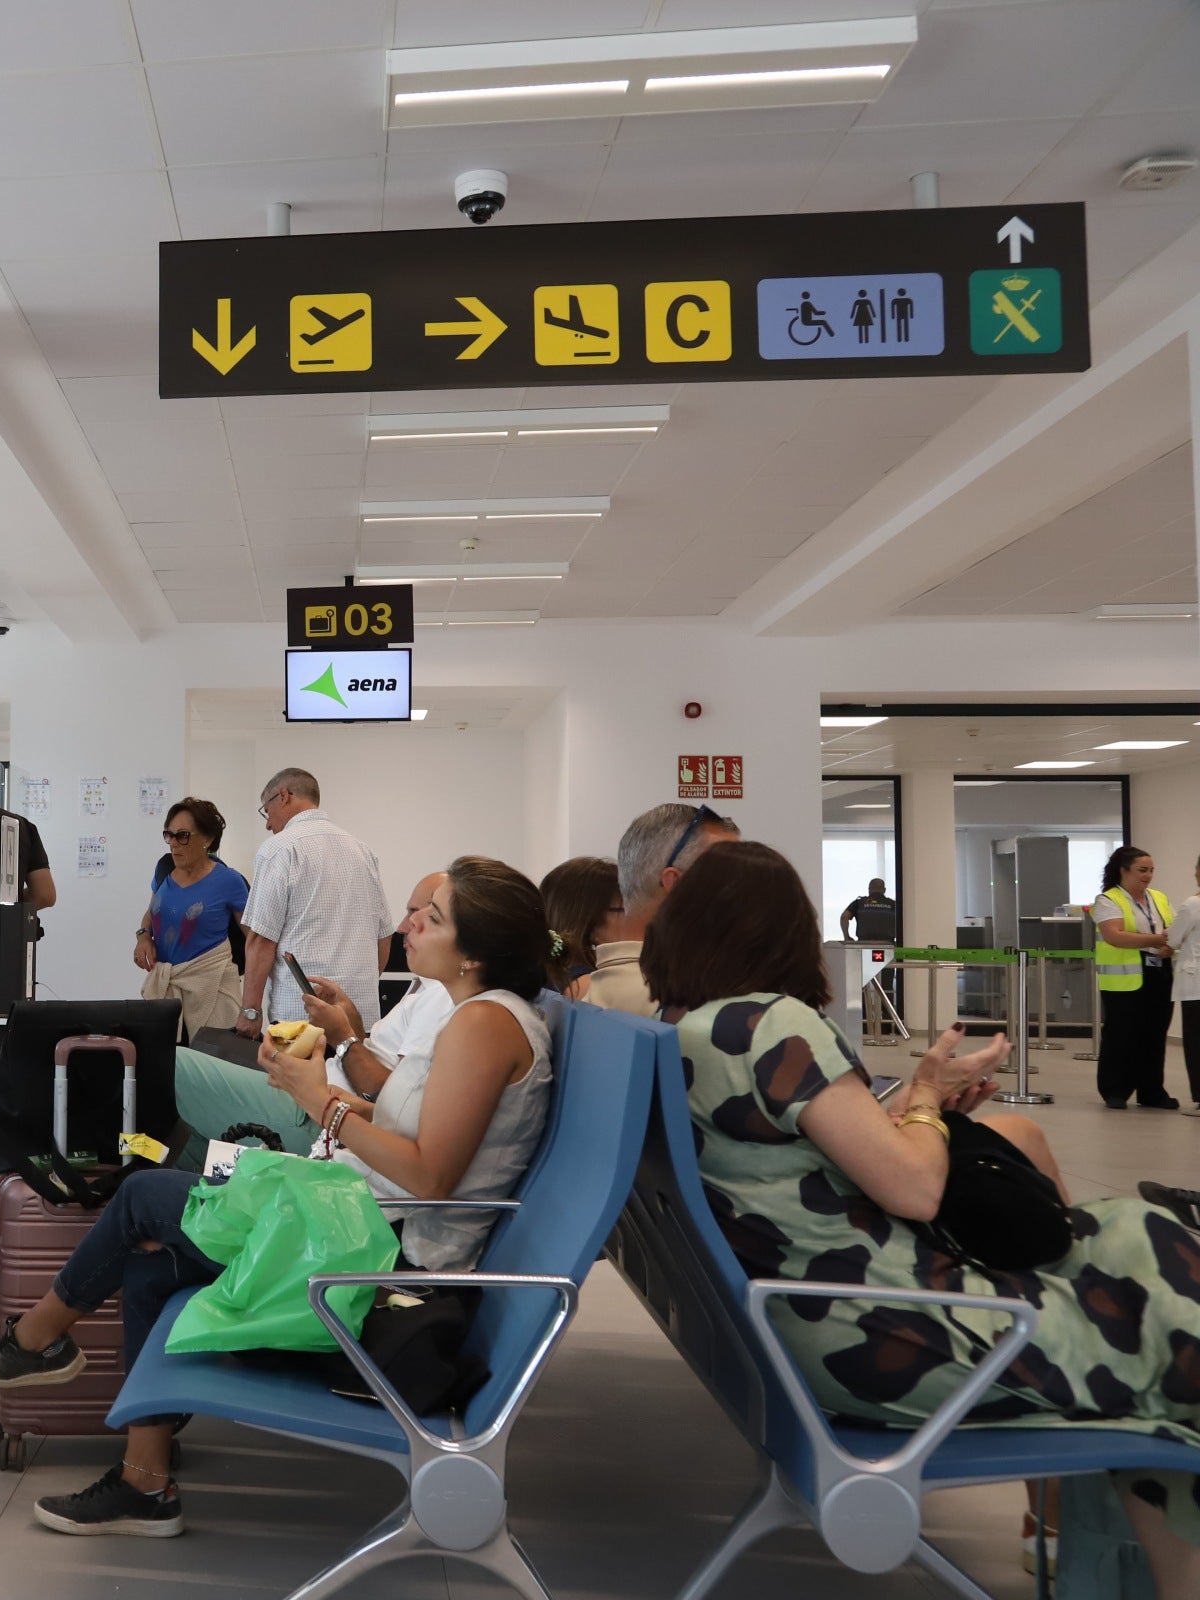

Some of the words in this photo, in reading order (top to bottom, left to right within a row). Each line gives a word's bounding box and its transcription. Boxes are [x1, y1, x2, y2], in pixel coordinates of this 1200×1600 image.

[665, 293, 711, 350] C
[344, 602, 393, 636] 03
[347, 678, 398, 692] aena
